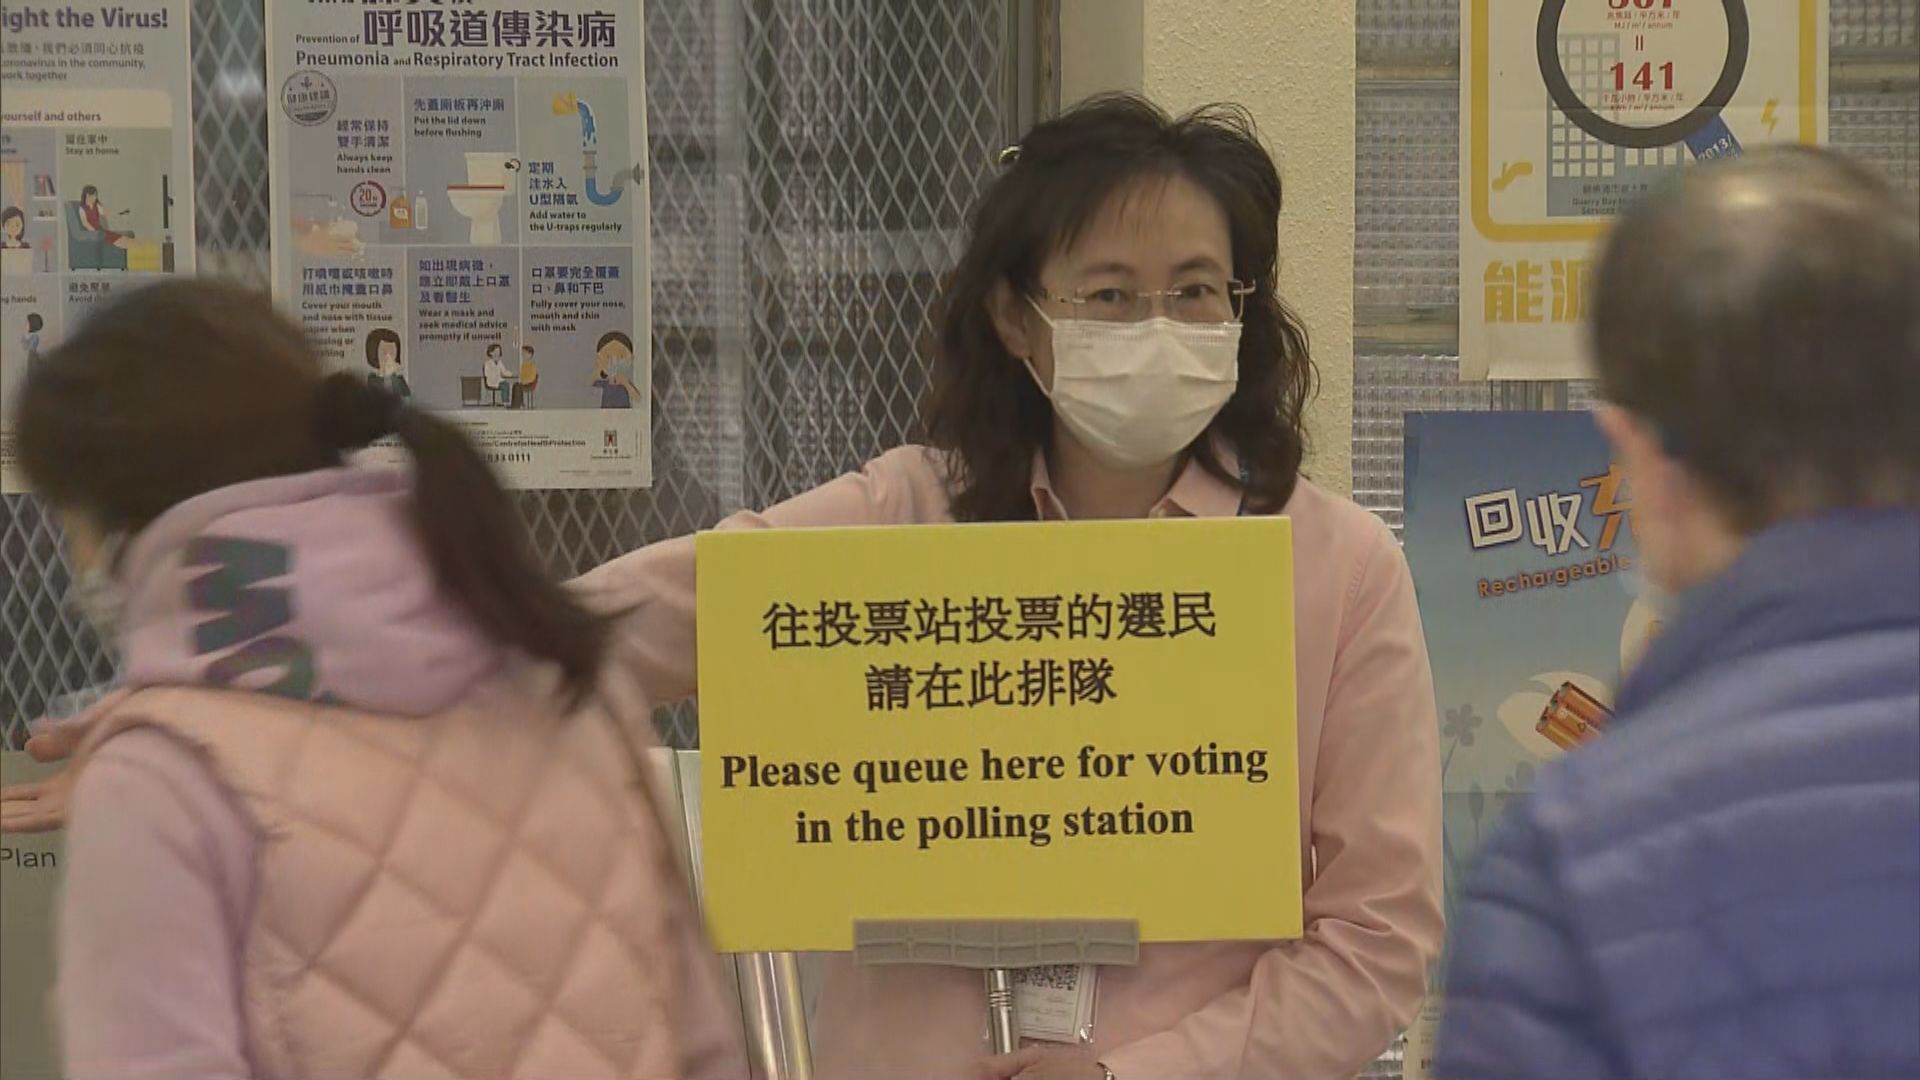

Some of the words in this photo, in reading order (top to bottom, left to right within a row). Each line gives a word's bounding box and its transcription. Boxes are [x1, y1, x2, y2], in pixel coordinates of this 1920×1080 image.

[56, 7, 95, 28] the
[101, 7, 168, 28] Virus!
[363, 9, 617, 48] 呼吸道傳染病
[296, 34, 349, 44] Prevention
[350, 34, 360, 44] of
[58, 58, 67, 67] in
[70, 58, 86, 67] the
[89, 58, 146, 70] community,
[296, 51, 390, 66] Pneumonia
[393, 57, 412, 66] and
[414, 51, 503, 70] Respiratory
[506, 51, 545, 67] Tract
[549, 51, 619, 68] Infection
[26, 71, 68, 82] together
[1610, 62, 1674, 91] 141
[45, 110, 65, 121] and
[67, 110, 102, 121] others
[414, 116, 429, 125] Put
[430, 116, 445, 125] the
[447, 116, 459, 125] lid
[461, 116, 486, 125] down
[414, 128, 442, 137] before
[445, 128, 482, 139] flushing
[65, 146, 83, 156] Stay
[96, 146, 119, 154] home
[337, 153, 368, 163] Always
[370, 153, 393, 163] keep
[337, 166, 364, 174] hands
[367, 166, 391, 174] clean
[528, 162, 555, 175] 定期
[530, 211, 547, 221] Add
[549, 211, 575, 220] water
[577, 211, 587, 220] to
[530, 223, 545, 232] the
[547, 223, 579, 233] U-traps
[581, 222, 622, 233] regularly
[69, 294, 93, 304] Avoid
[302, 301, 327, 310] Cover
[330, 303, 350, 312] your
[352, 301, 382, 310] mouth
[531, 300, 551, 310] Fully
[553, 302, 578, 310] cover
[580, 302, 600, 311] your
[602, 302, 626, 310] nose,
[302, 313, 317, 322] and
[320, 314, 341, 322] nose
[344, 313, 364, 322] with
[367, 313, 393, 322] tissue
[419, 309, 440, 317] Wear
[450, 309, 473, 317] mask
[476, 309, 494, 317] and
[531, 312, 558, 321] mouth
[561, 312, 580, 321] and
[581, 312, 600, 321] chin
[331, 325, 355, 334] when
[419, 321, 439, 329] seek
[441, 321, 476, 329] medical
[479, 321, 507, 329] advice
[531, 324, 550, 332] with
[552, 324, 576, 332] mask
[419, 333, 461, 343] promptly
[464, 333, 471, 341] if
[473, 333, 502, 341] unwell
[508, 453, 532, 462] 0111
[1477, 556, 1632, 598] Rechargeable
[763, 592, 1217, 650] 往投票站投票的選民
[865, 658, 1118, 711] 請在此排隊
[721, 755, 840, 788] Please
[853, 757, 968, 793] queue
[981, 748, 1064, 781] here
[1077, 745, 1134, 777] for
[1147, 742, 1269, 782] voting
[796, 810, 831, 843] in
[846, 808, 904, 841] the
[917, 806, 1050, 849] polling
[1063, 802, 1194, 836] station
